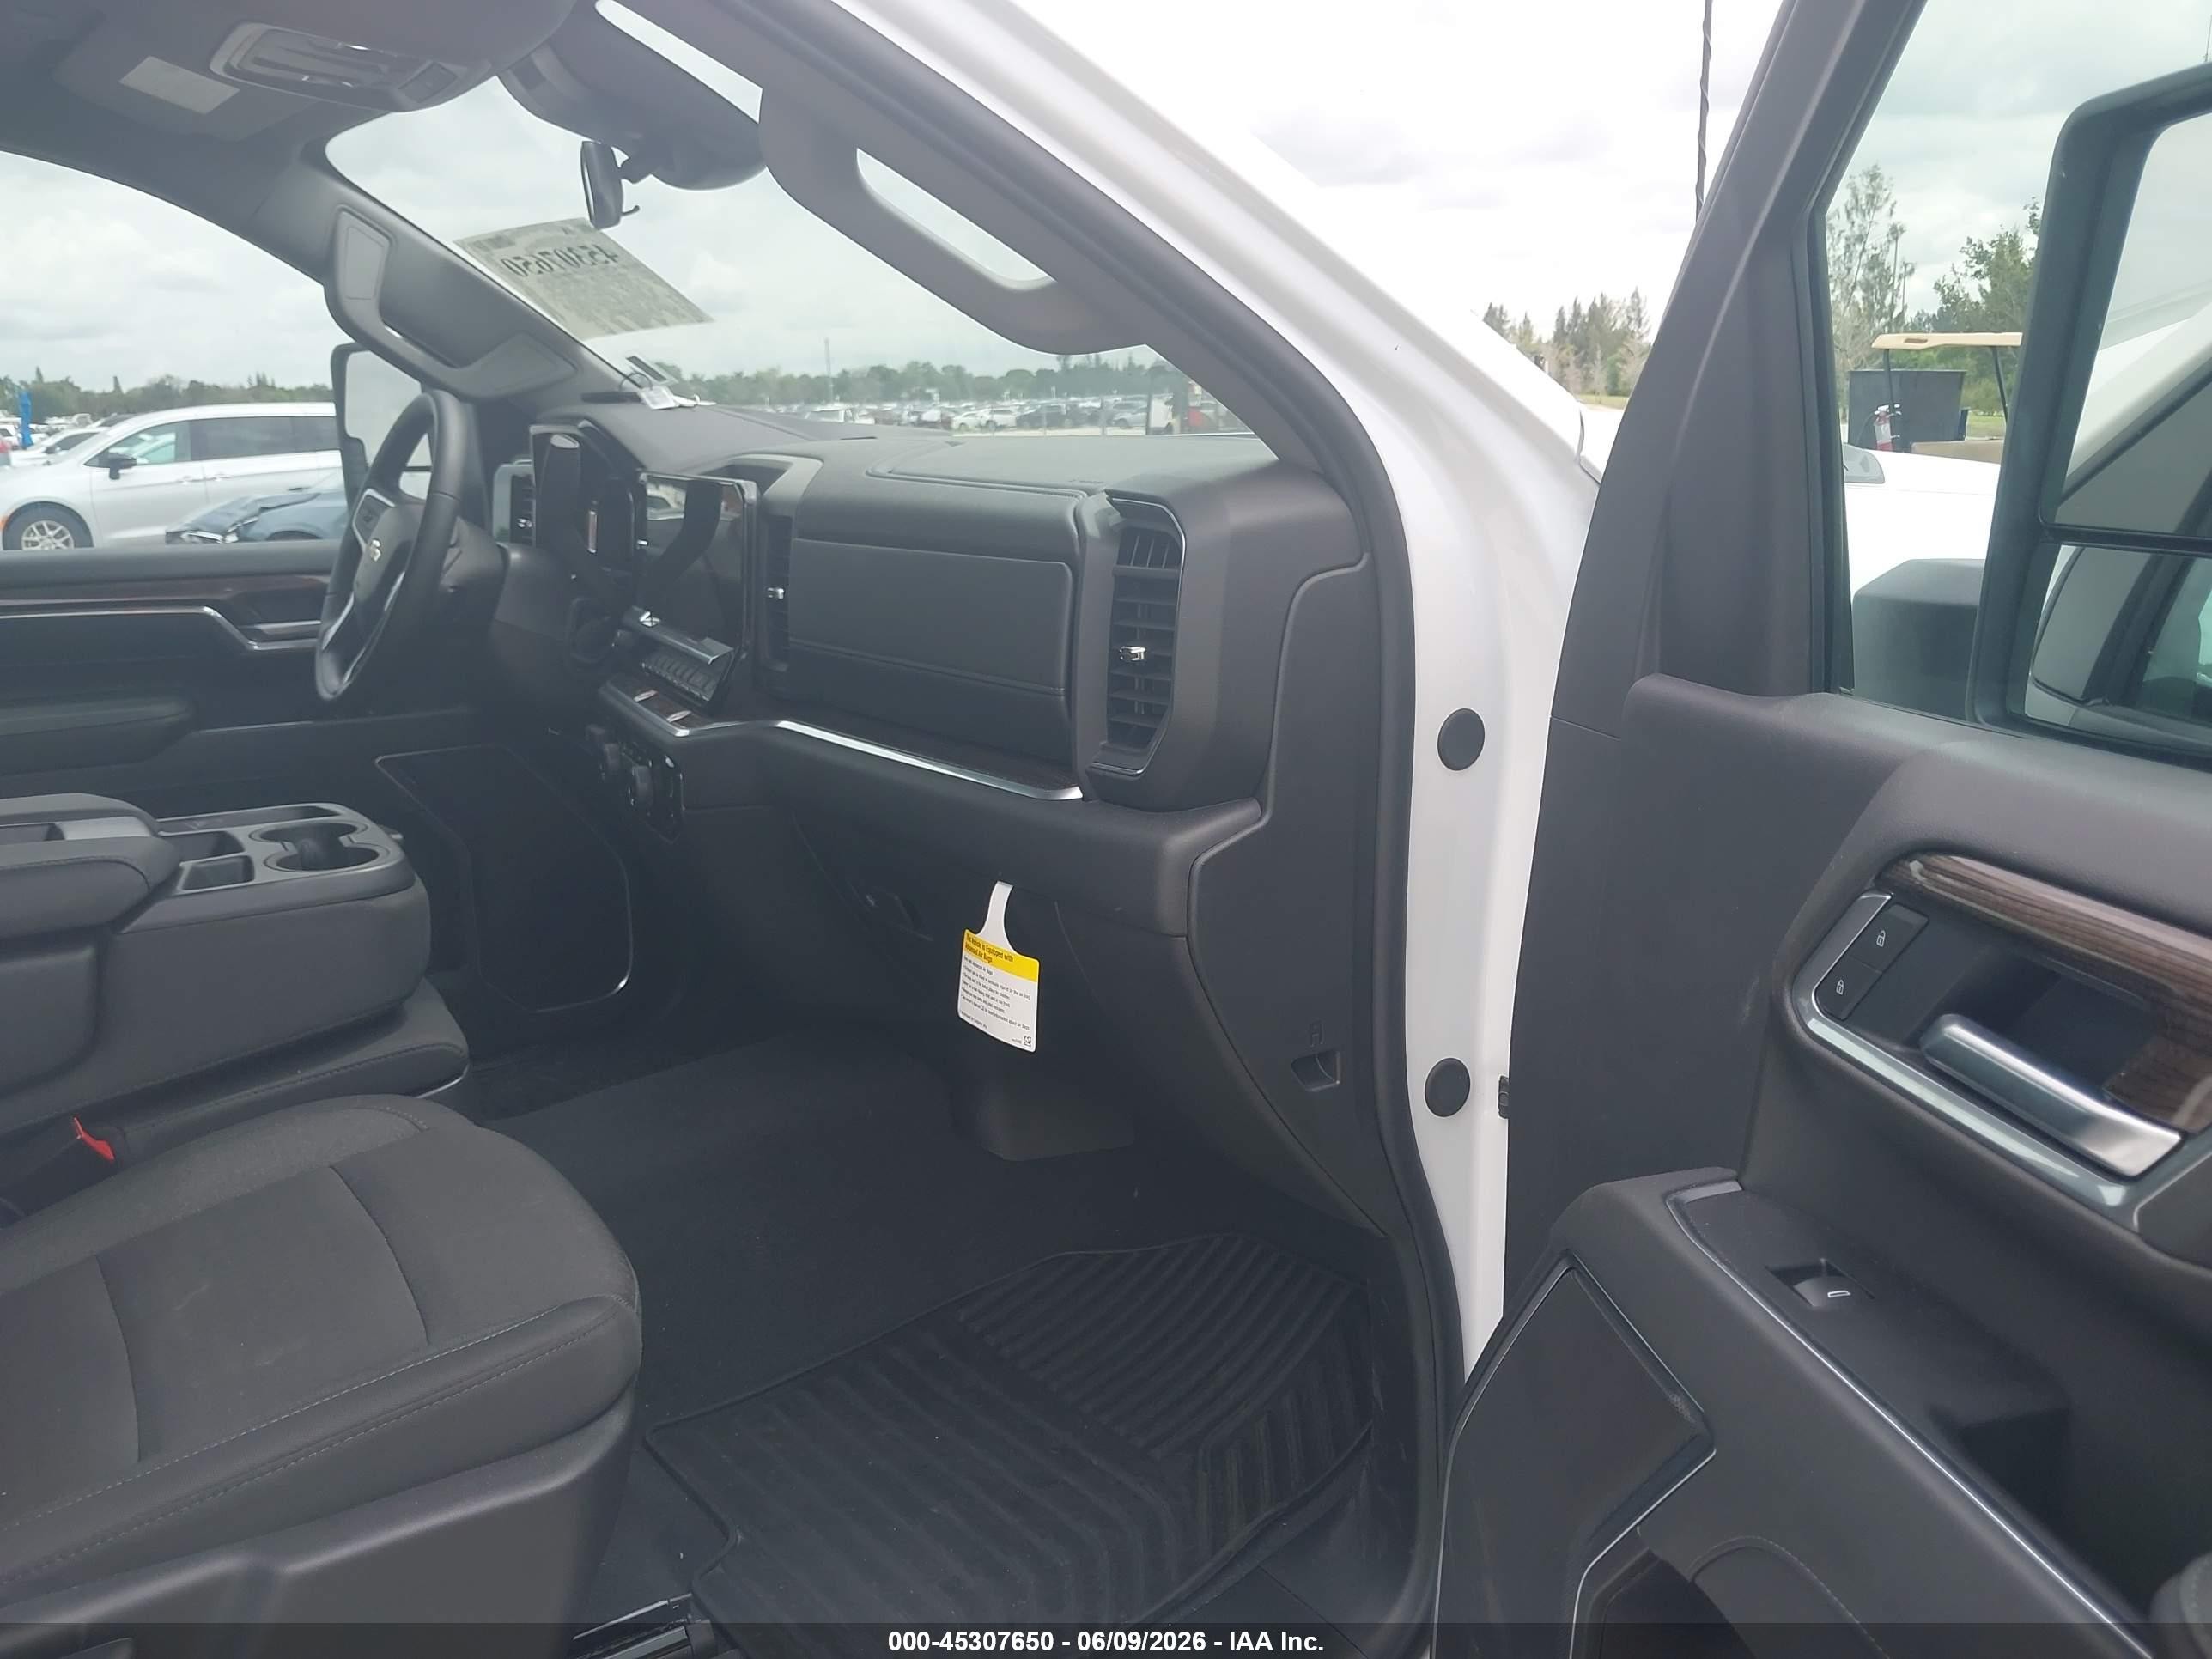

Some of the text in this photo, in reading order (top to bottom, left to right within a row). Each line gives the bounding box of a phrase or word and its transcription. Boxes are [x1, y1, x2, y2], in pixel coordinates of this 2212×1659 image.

[983, 951, 993, 963] Bags
[986, 945, 1003, 959] Equipped
[1004, 953, 1013, 962] with
